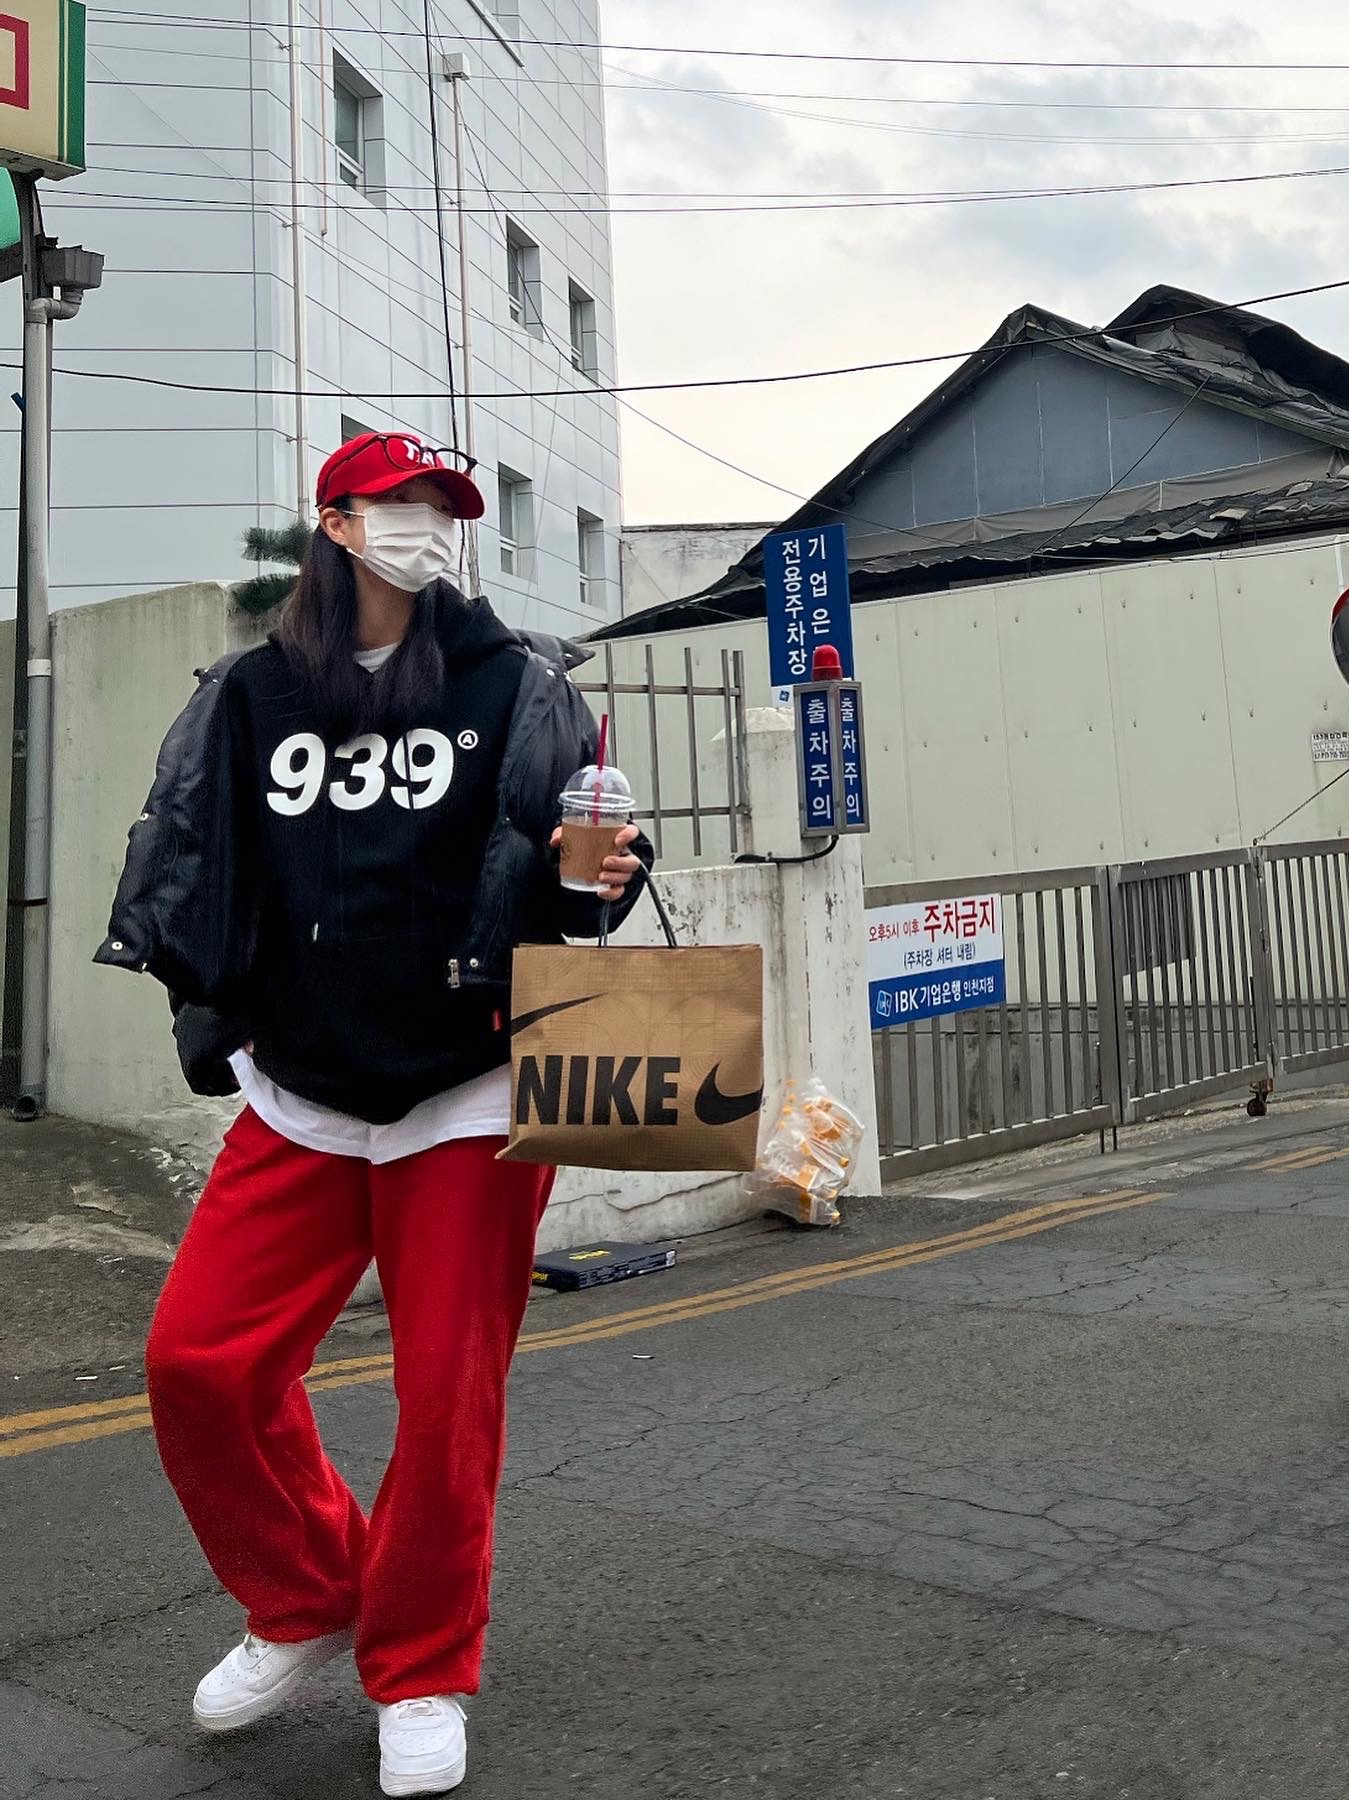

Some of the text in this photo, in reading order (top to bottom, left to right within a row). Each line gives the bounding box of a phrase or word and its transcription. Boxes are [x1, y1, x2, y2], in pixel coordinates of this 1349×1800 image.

[781, 538, 807, 675] 전용주차장
[807, 534, 831, 655] 기업은
[266, 727, 454, 816] 939
[806, 698, 831, 820] 출차주의
[840, 697, 860, 818] 출차주의
[868, 897, 996, 943] 오후5시 이후 주차금지
[903, 941, 976, 970] (주차장 셔터 내림)
[963, 975, 995, 998] 인천지점
[516, 1055, 681, 1126] NIKE
